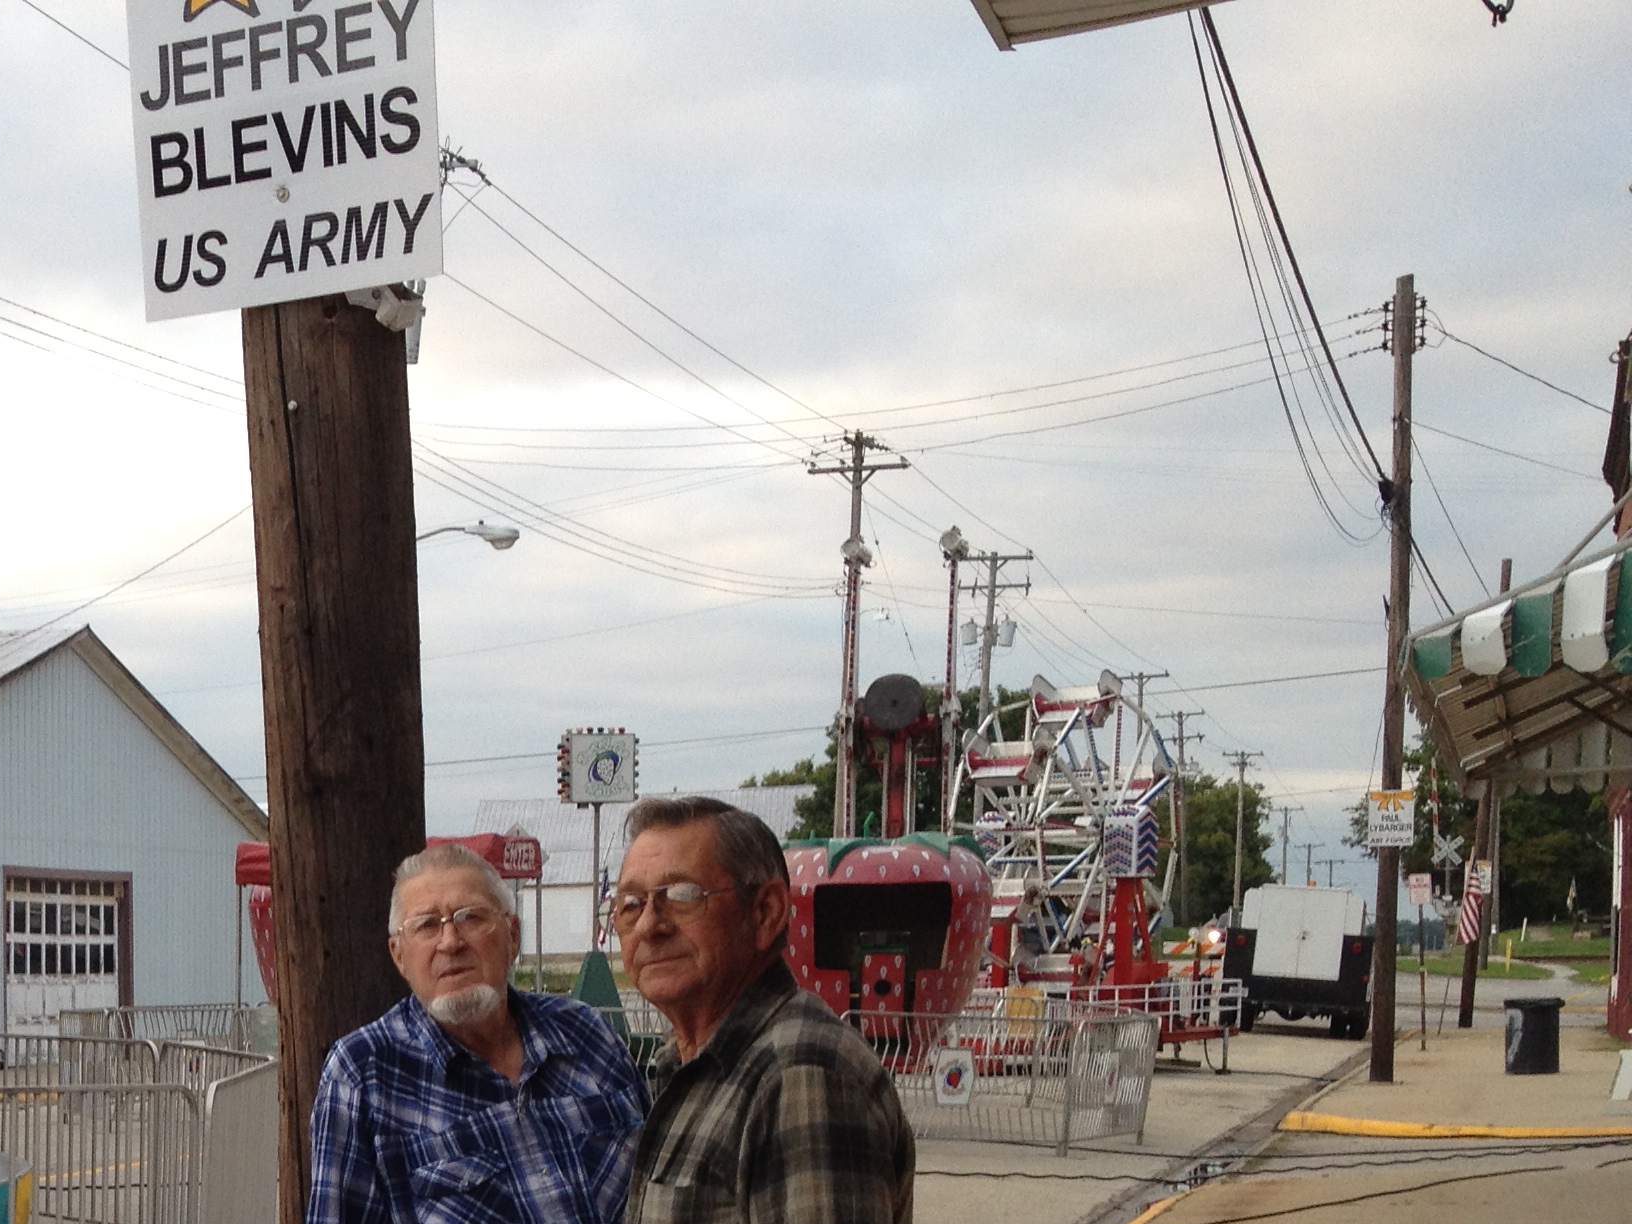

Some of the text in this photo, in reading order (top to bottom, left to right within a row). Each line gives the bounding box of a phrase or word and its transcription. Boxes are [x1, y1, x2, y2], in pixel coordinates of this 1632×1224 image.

[139, 0, 419, 111] JEFFREY
[150, 86, 421, 198] BLEVINS
[154, 192, 434, 293] US ARMY
[503, 841, 536, 871] ENTER
